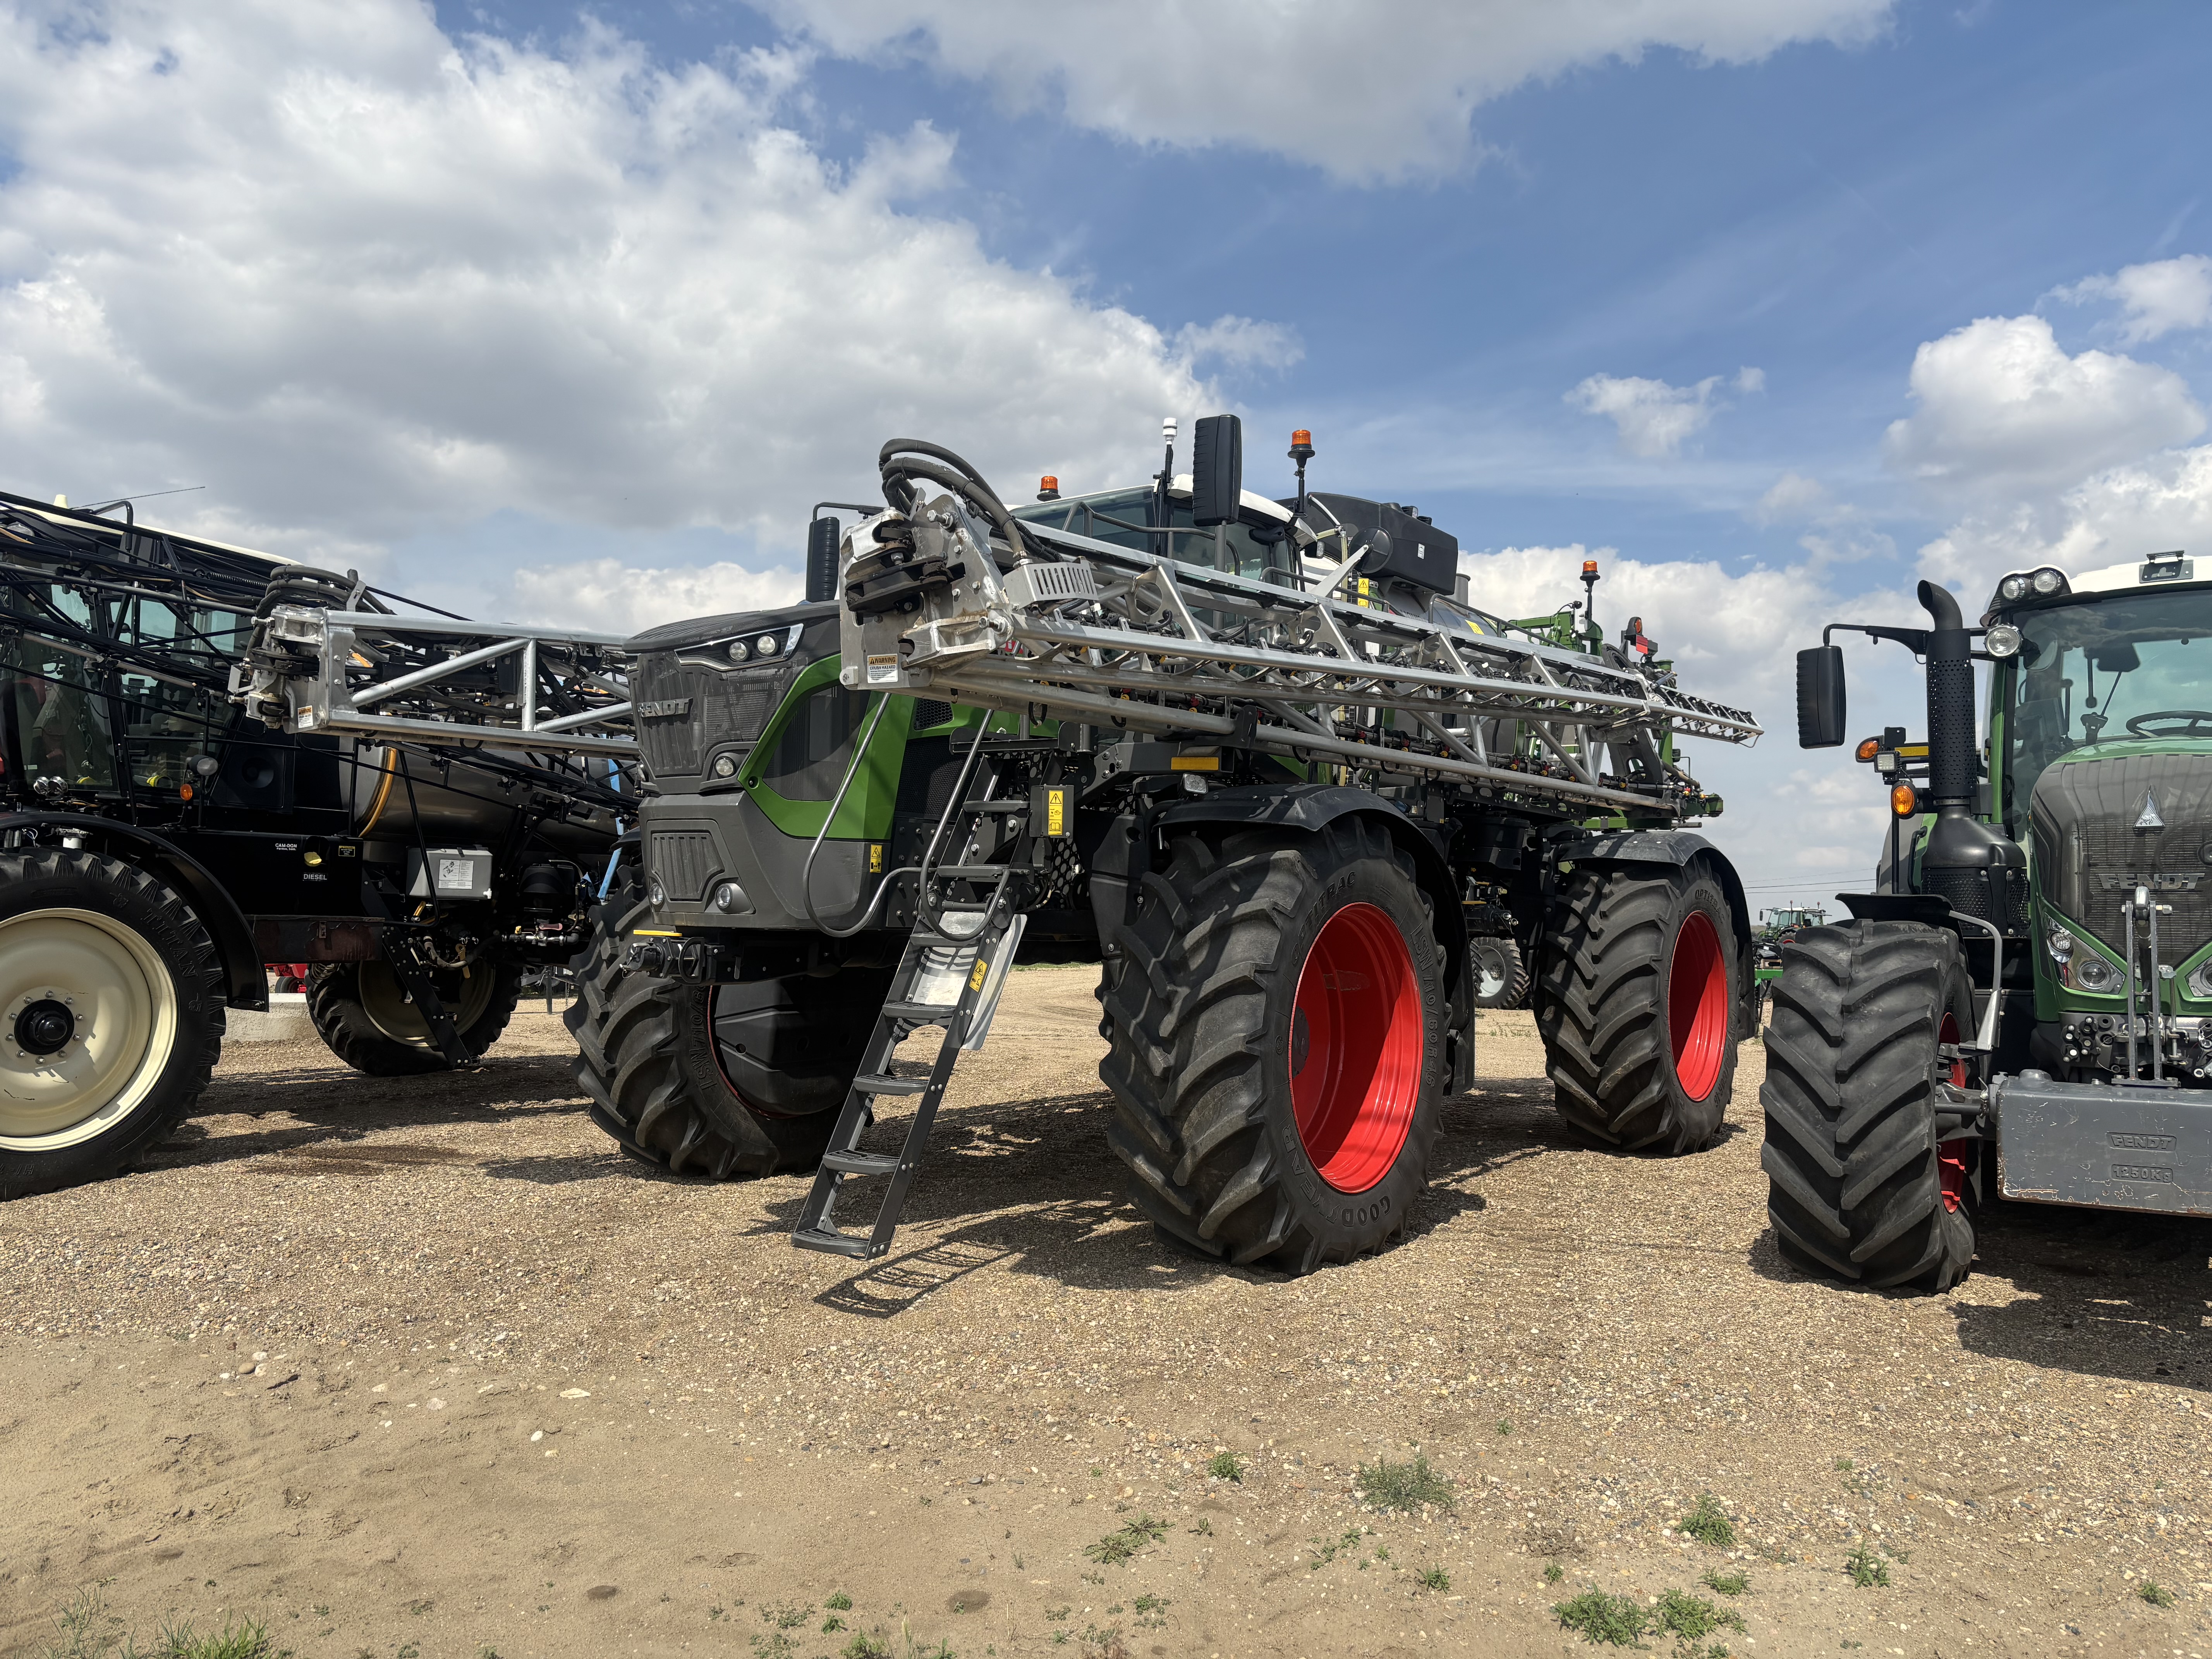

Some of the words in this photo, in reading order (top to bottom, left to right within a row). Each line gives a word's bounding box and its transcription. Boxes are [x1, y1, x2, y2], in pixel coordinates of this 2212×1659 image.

[637, 697, 693, 718] FENDT
[2099, 873, 2205, 890] FENDT
[140, 908, 199, 977] TITAN
[2111, 1135, 2172, 1149] FENDT
[1282, 1124, 1391, 1227] GOODYEAR
